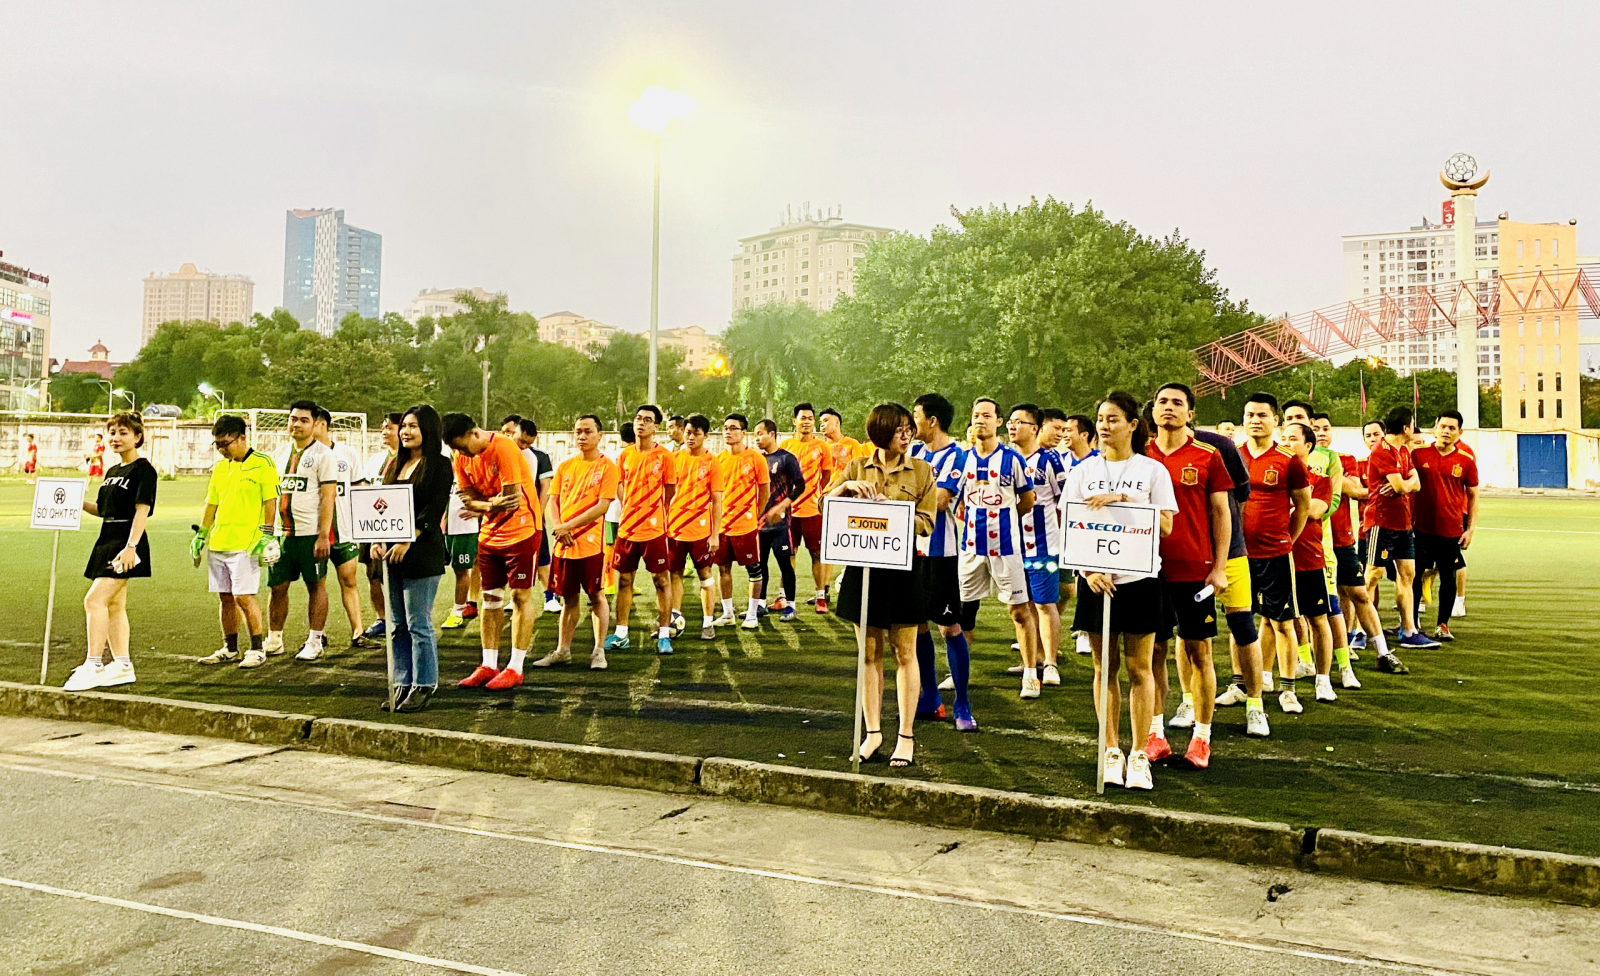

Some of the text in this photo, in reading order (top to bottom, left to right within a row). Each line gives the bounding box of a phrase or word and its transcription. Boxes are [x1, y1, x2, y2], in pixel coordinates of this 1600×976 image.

[280, 479, 305, 491] eep
[49, 507, 68, 519] QHKT
[69, 508, 78, 520] FC
[359, 518, 404, 532] VNCC FC
[858, 519, 887, 530] JOTUN
[832, 533, 901, 552] JOTUN FC
[1096, 538, 1120, 555] FC
[458, 553, 470, 564] 88
